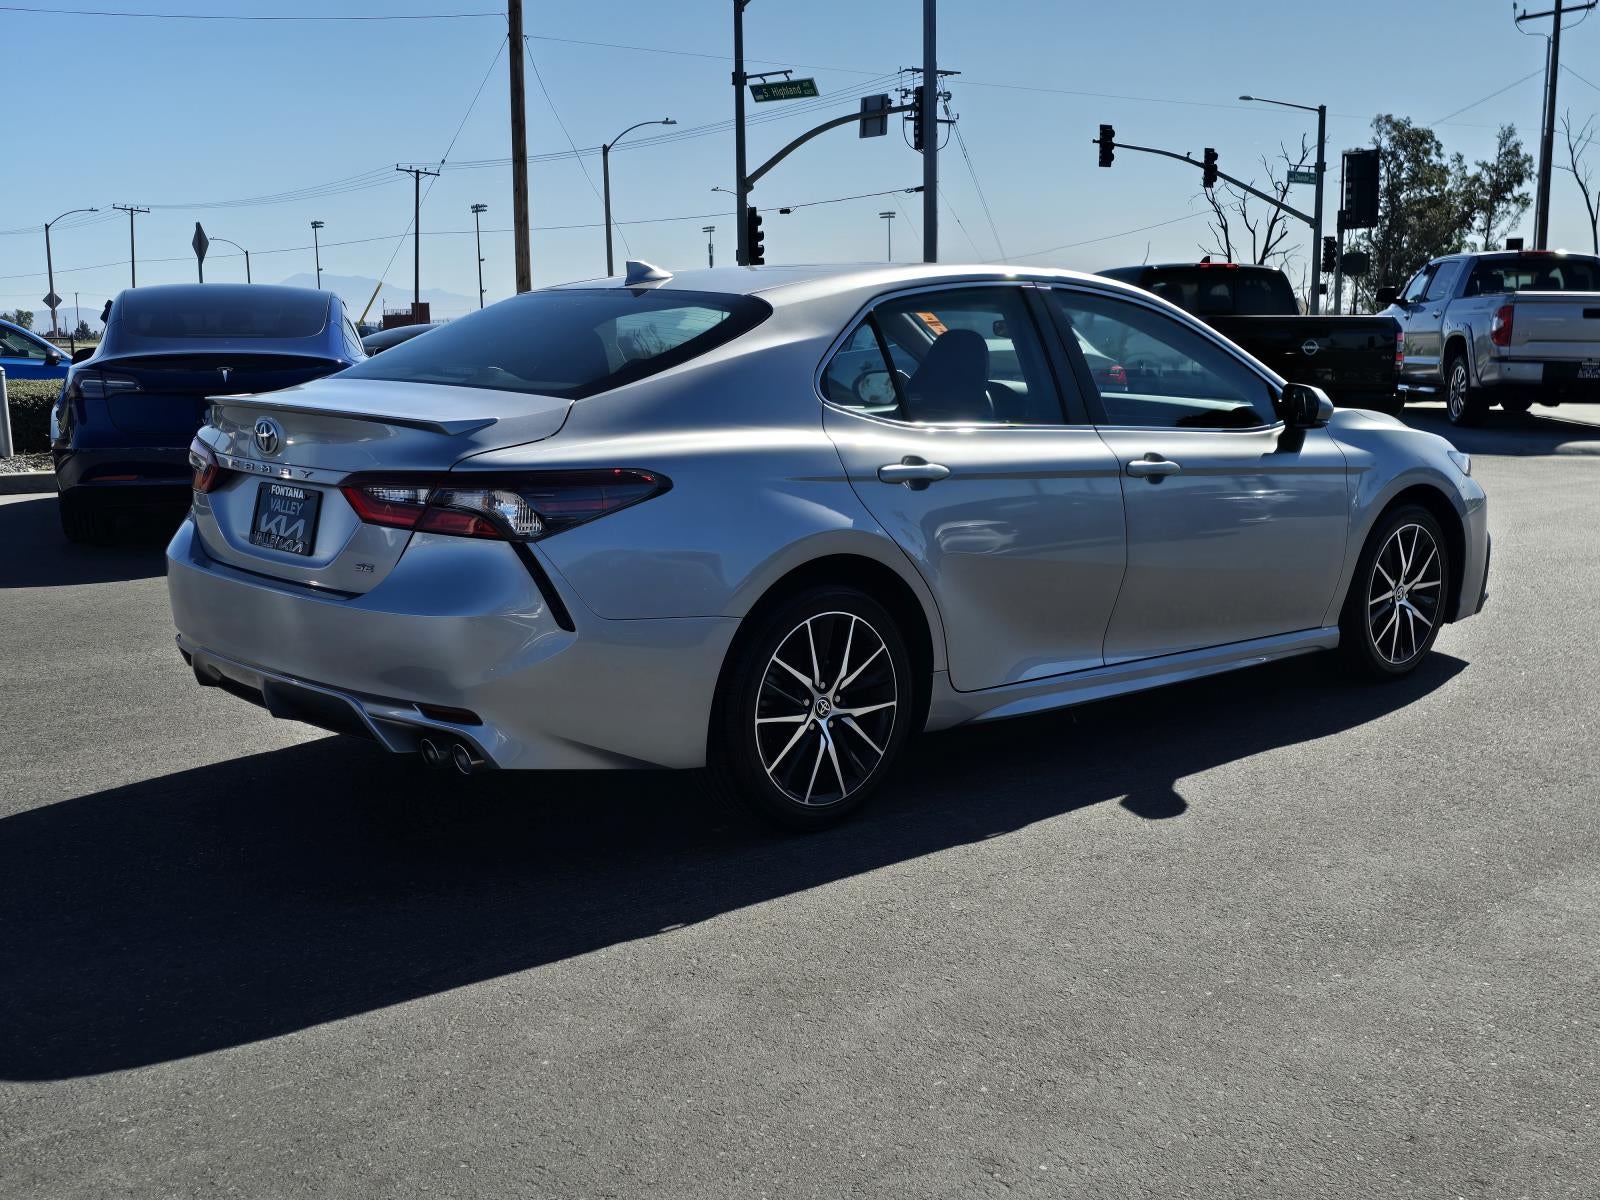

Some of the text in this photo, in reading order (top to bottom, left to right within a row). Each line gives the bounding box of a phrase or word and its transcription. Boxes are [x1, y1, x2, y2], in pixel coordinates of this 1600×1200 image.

[771, 85, 802, 99] Highland
[271, 485, 304, 499] FONTANA
[271, 499, 303, 515] VALLEY
